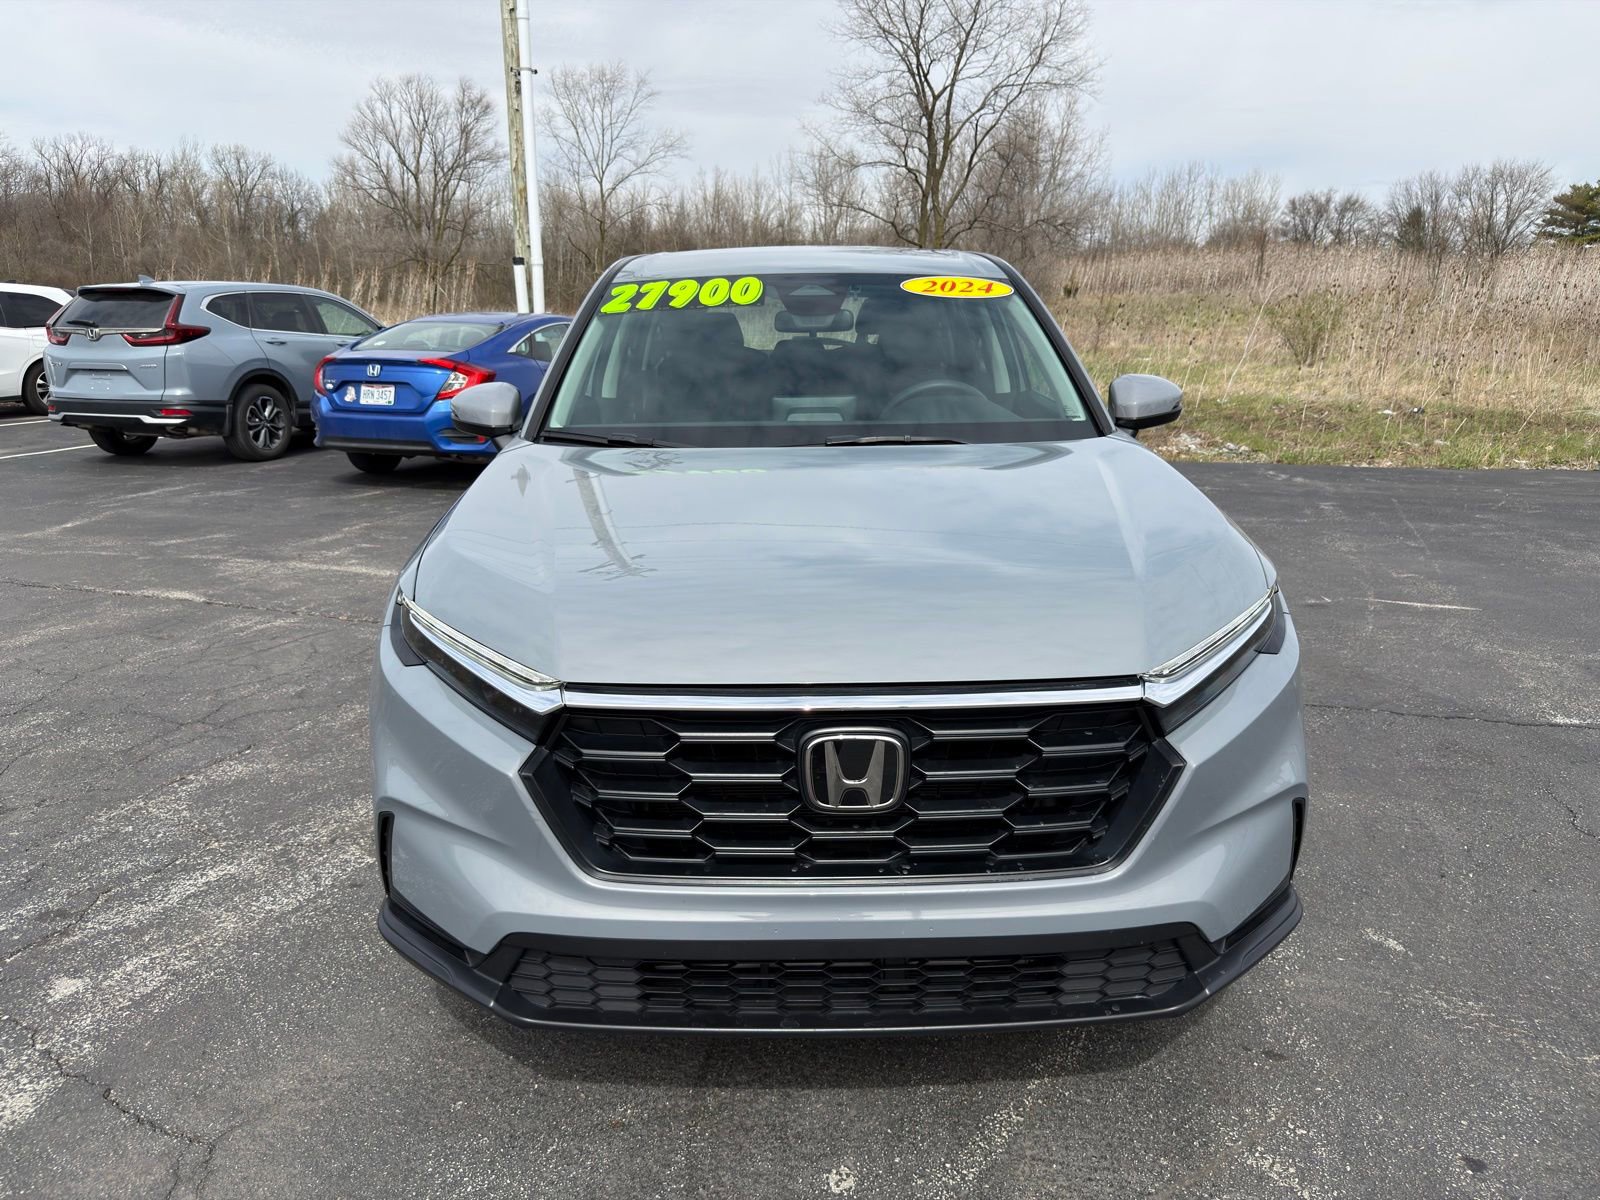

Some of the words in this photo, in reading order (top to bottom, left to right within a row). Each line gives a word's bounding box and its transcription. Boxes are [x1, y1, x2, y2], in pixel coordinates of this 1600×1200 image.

[921, 280, 994, 294] 2024
[600, 276, 764, 313] 27900
[376, 389, 392, 400] 3457
